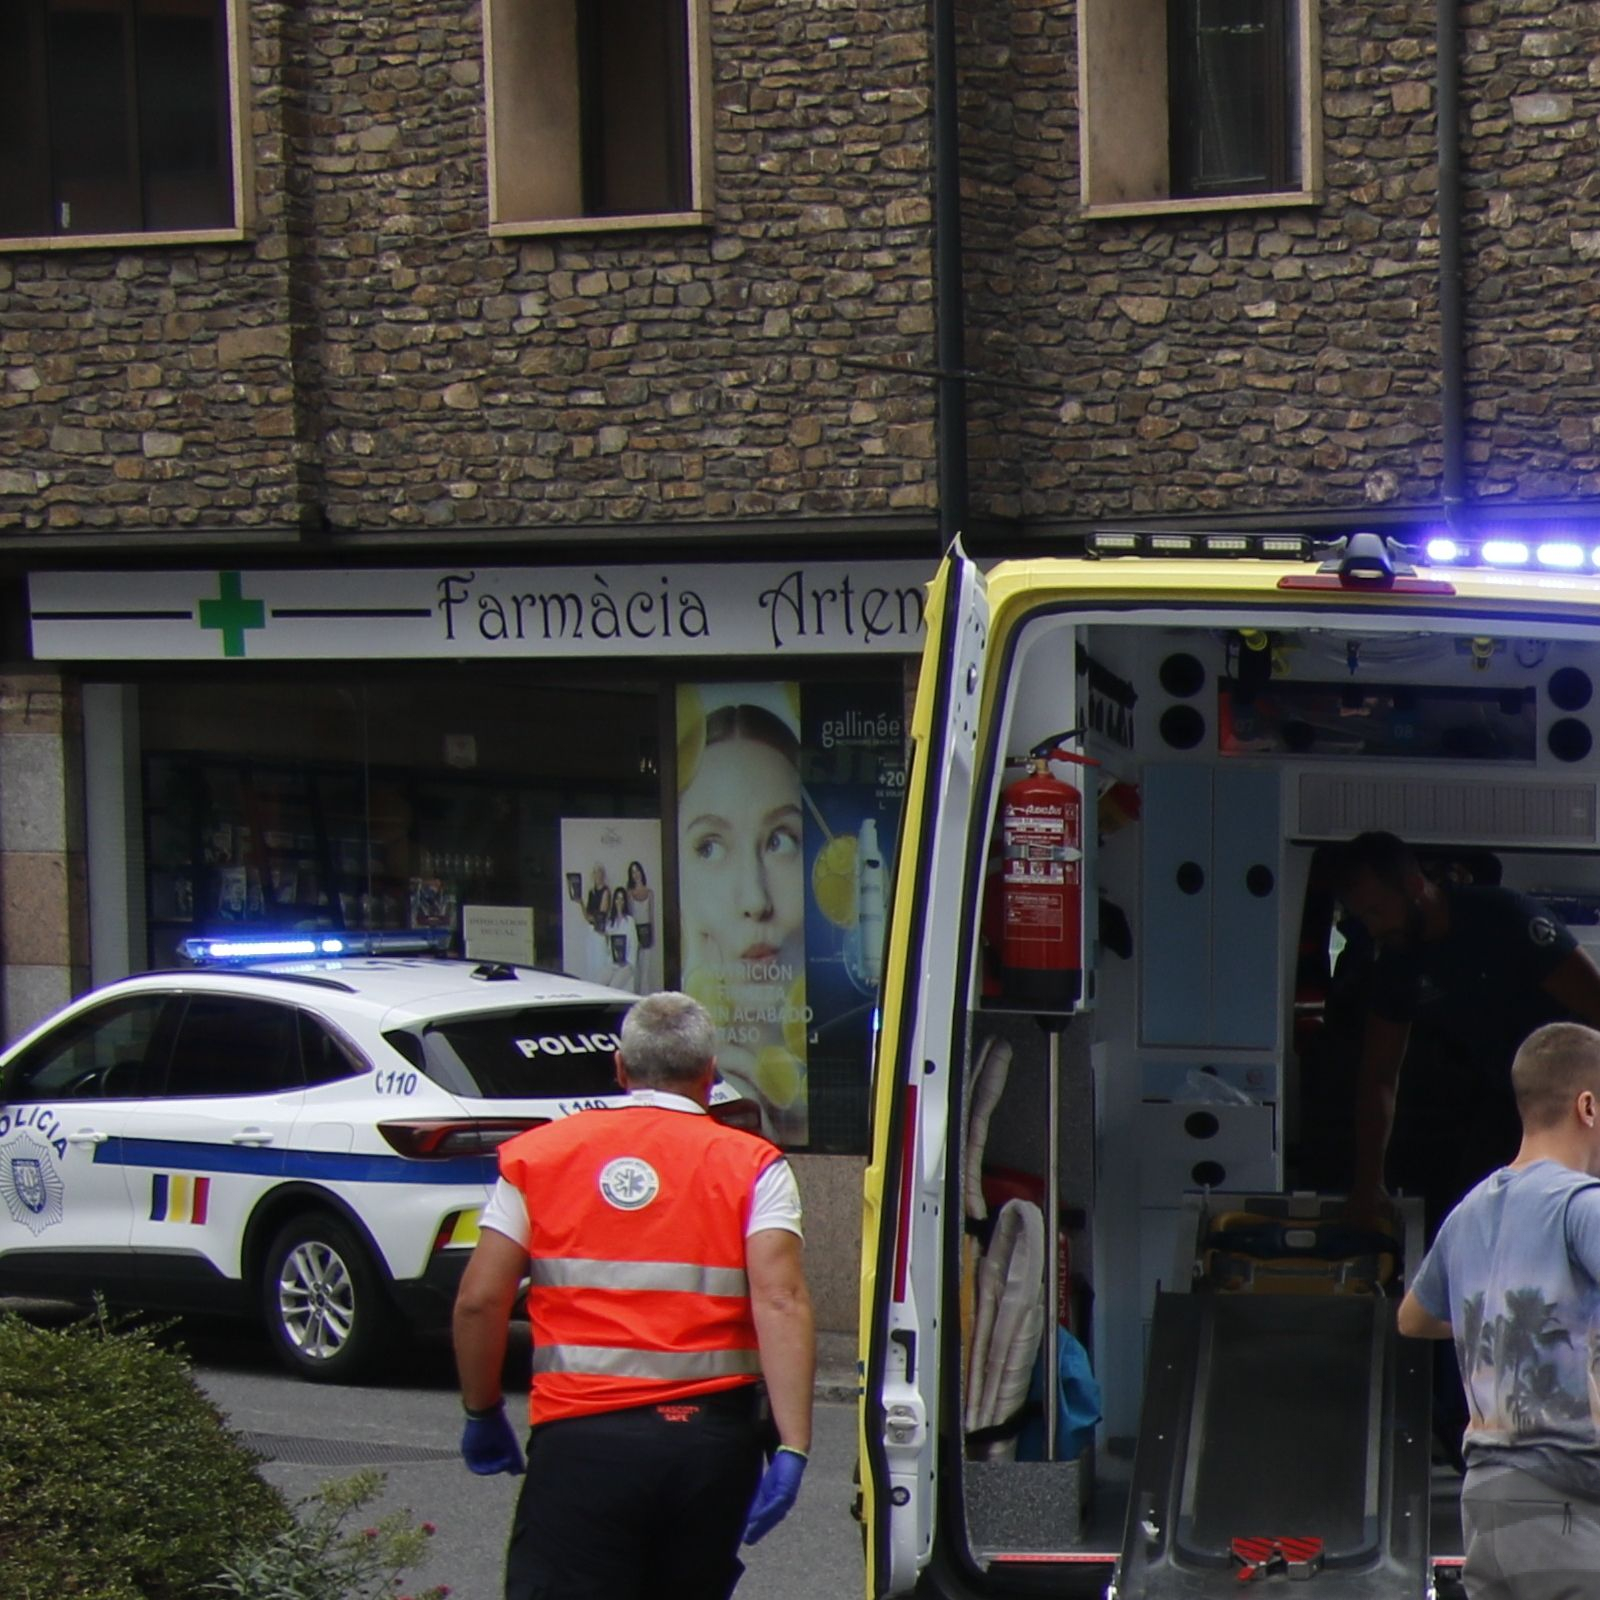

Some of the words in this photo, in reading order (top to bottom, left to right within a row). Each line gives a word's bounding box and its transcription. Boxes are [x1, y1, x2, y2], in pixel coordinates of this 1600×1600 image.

[436, 570, 711, 641] Farmàcia
[822, 711, 901, 749] gallinée
[734, 1006, 813, 1024] ACABADO
[515, 1033, 621, 1059] POLICI
[384, 1071, 418, 1096] 110
[0, 1106, 69, 1161] OLICIA
